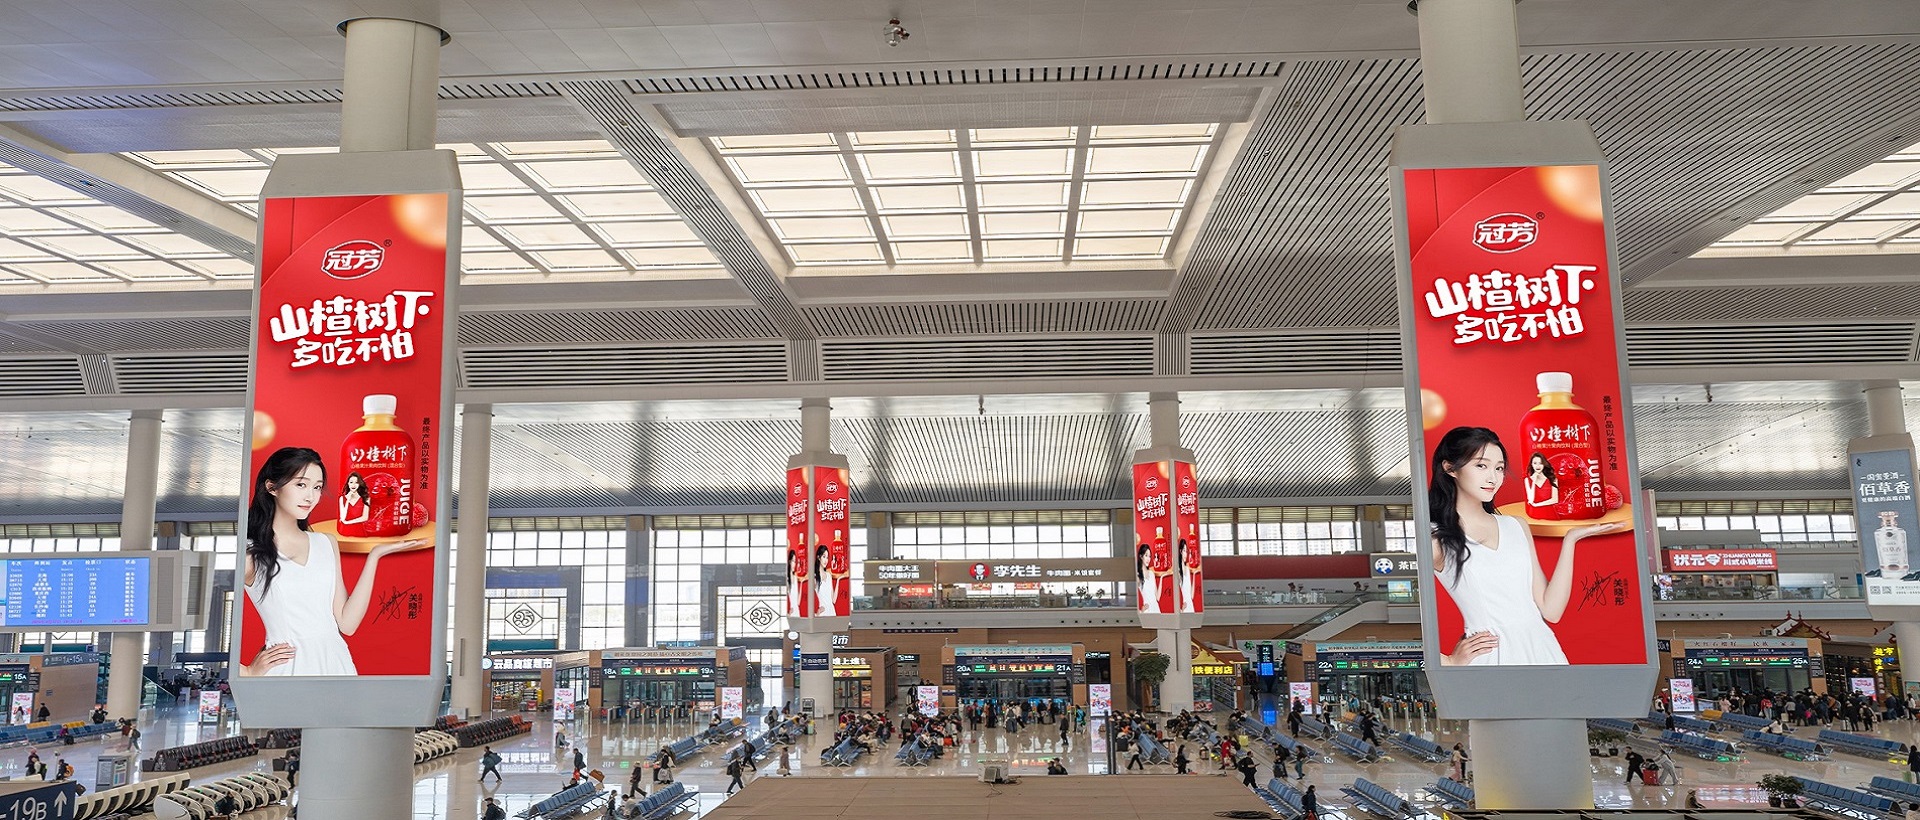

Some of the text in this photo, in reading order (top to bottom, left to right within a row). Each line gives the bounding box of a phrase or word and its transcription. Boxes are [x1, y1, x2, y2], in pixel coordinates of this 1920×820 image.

[1477, 222, 1536, 244] 冠芳
[326, 249, 382, 271] 冠芳
[1425, 265, 1597, 318] 山楂树下
[270, 290, 434, 343] 山楂树下
[1453, 304, 1584, 344] 多吃不怕
[291, 329, 414, 368] 多吃不怕
[1530, 424, 1591, 442] 山楂树下
[1602, 395, 1618, 471] 最终产品以实物为准
[350, 444, 408, 463] 山楂树下
[419, 417, 431, 490] 最终产品以实物为准
[1587, 458, 1603, 508] JUICE
[1859, 480, 1910, 496] 佰草香
[398, 478, 411, 525] JUICE
[994, 564, 1041, 578] 李先生
[1673, 553, 1720, 567] 状元令
[956, 664, 971, 672] 20A
[1056, 664, 1071, 672] 21A
[1318, 661, 1333, 669] 22A
[1792, 657, 1809, 665] 25A
